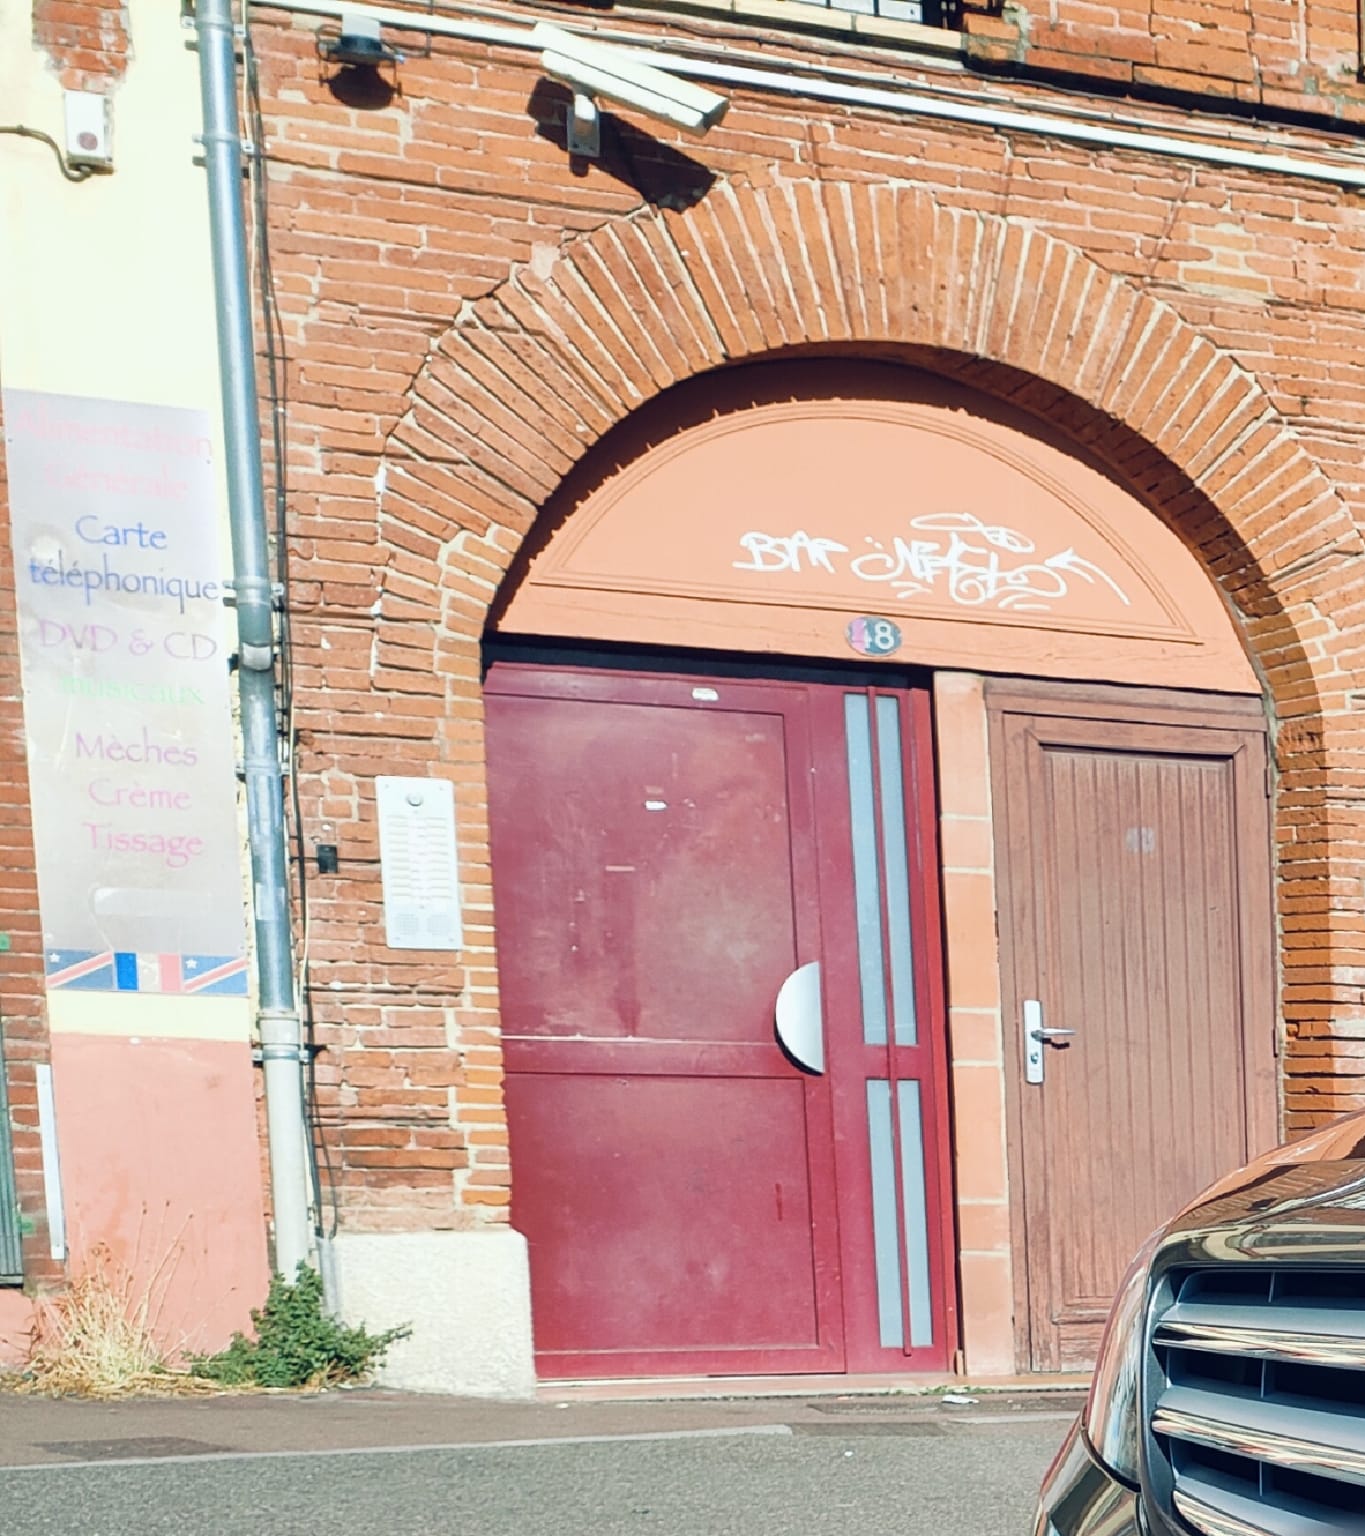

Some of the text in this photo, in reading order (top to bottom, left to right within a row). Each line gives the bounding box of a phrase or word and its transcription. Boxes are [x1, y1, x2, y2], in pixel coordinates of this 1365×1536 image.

[75, 514, 167, 550] Carte
[29, 549, 219, 614] téléphonique
[38, 618, 217, 660] DVD & CD
[75, 726, 198, 767] Mèches
[88, 777, 192, 810] Crème
[81, 821, 205, 869] Tissage
